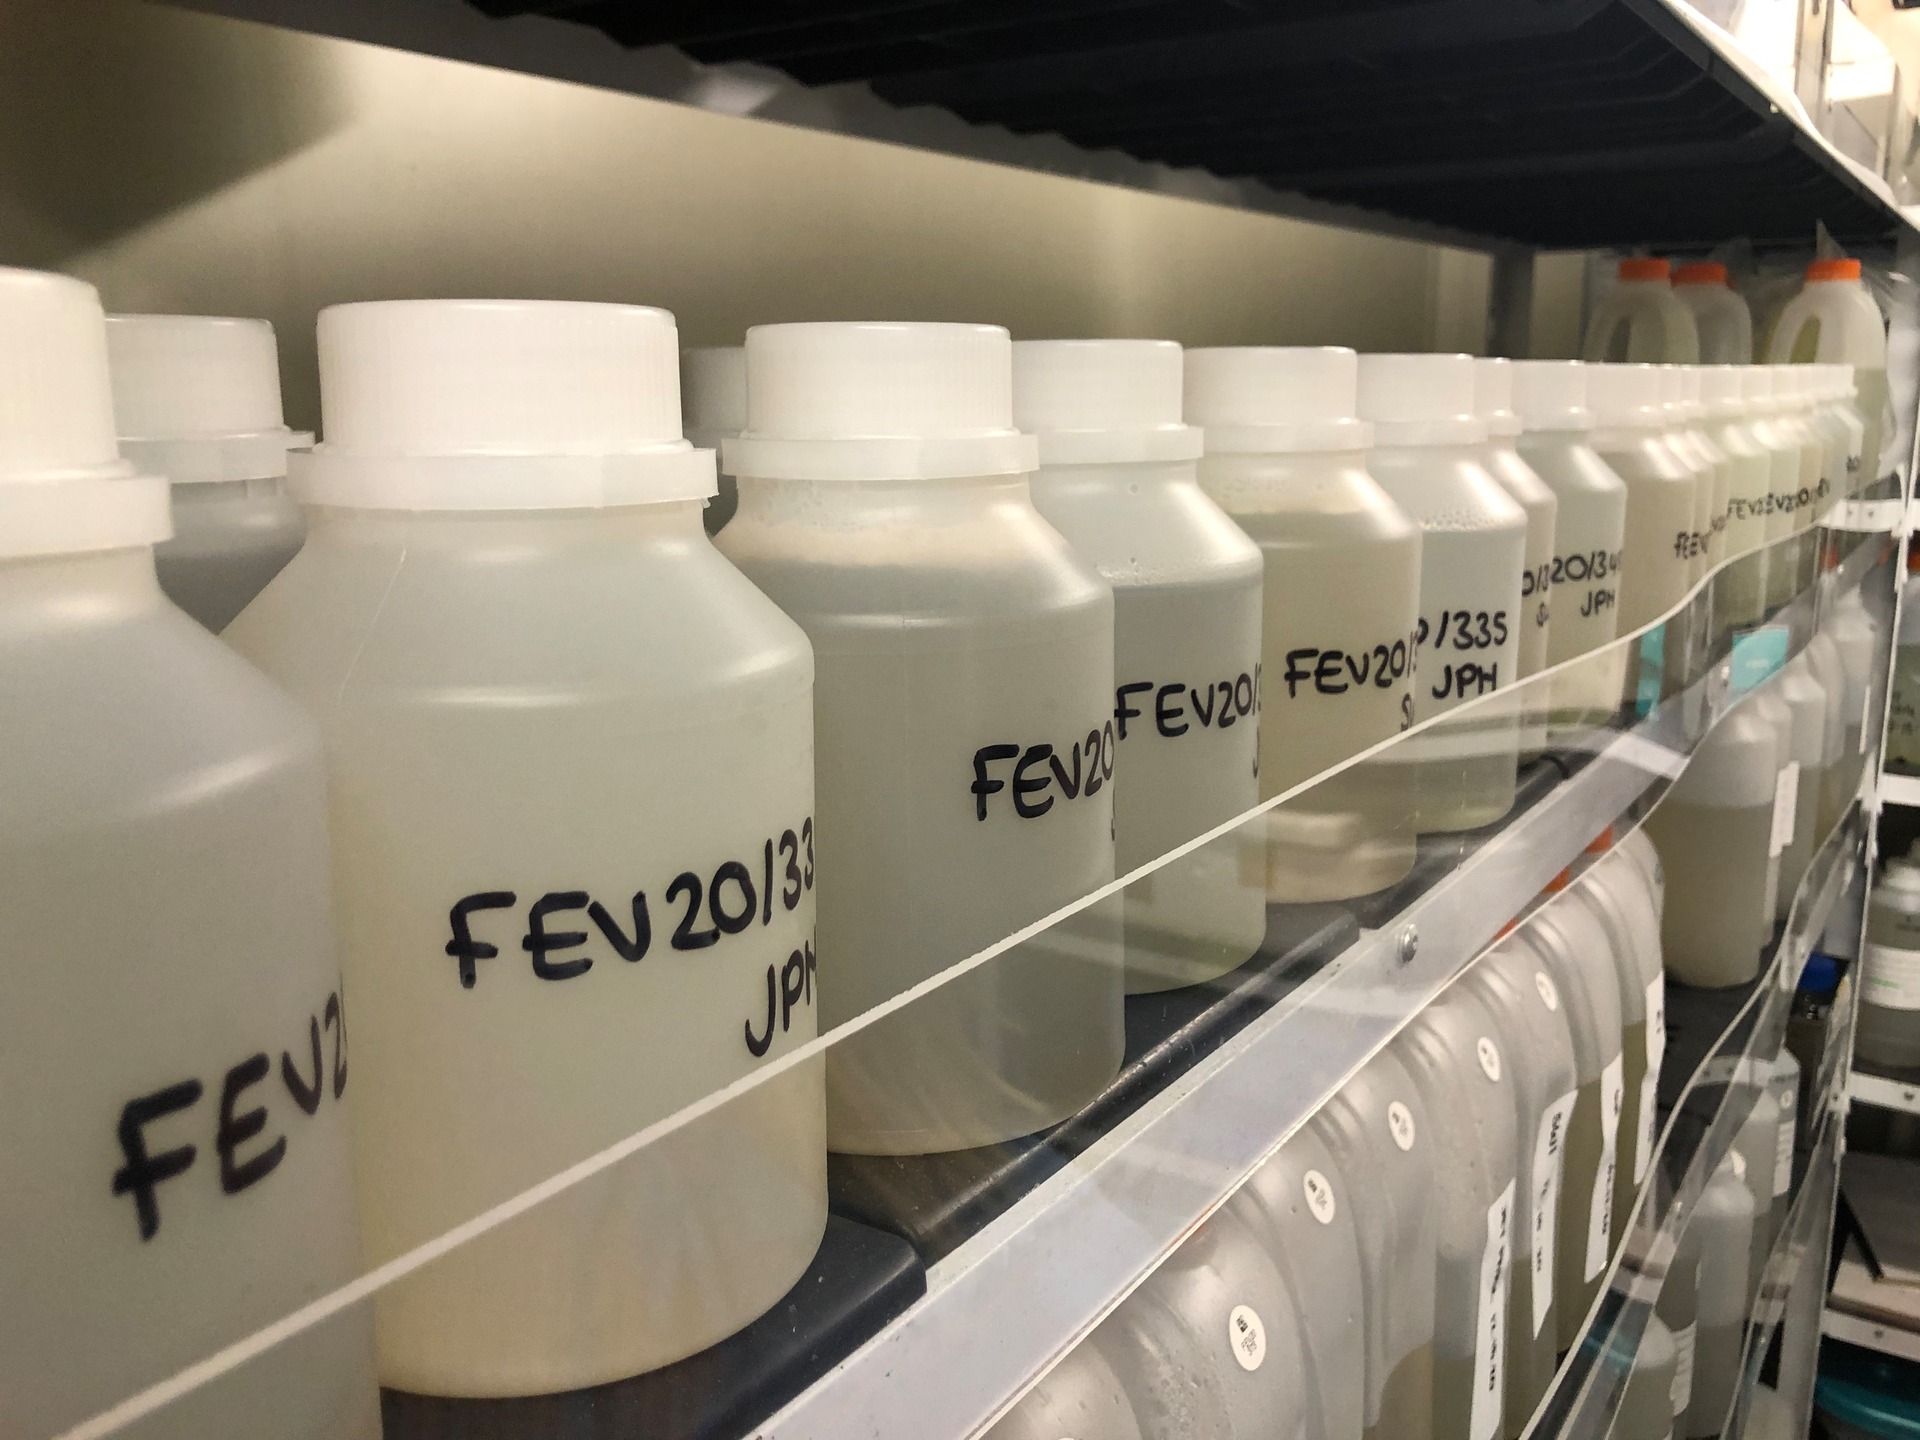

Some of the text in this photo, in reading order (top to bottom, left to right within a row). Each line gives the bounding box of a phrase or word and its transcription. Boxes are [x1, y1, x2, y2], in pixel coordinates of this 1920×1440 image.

[1284, 631, 1418, 699] FEV20/
[1431, 661, 1498, 699] JPH
[1114, 662, 1261, 742] FEV20/
